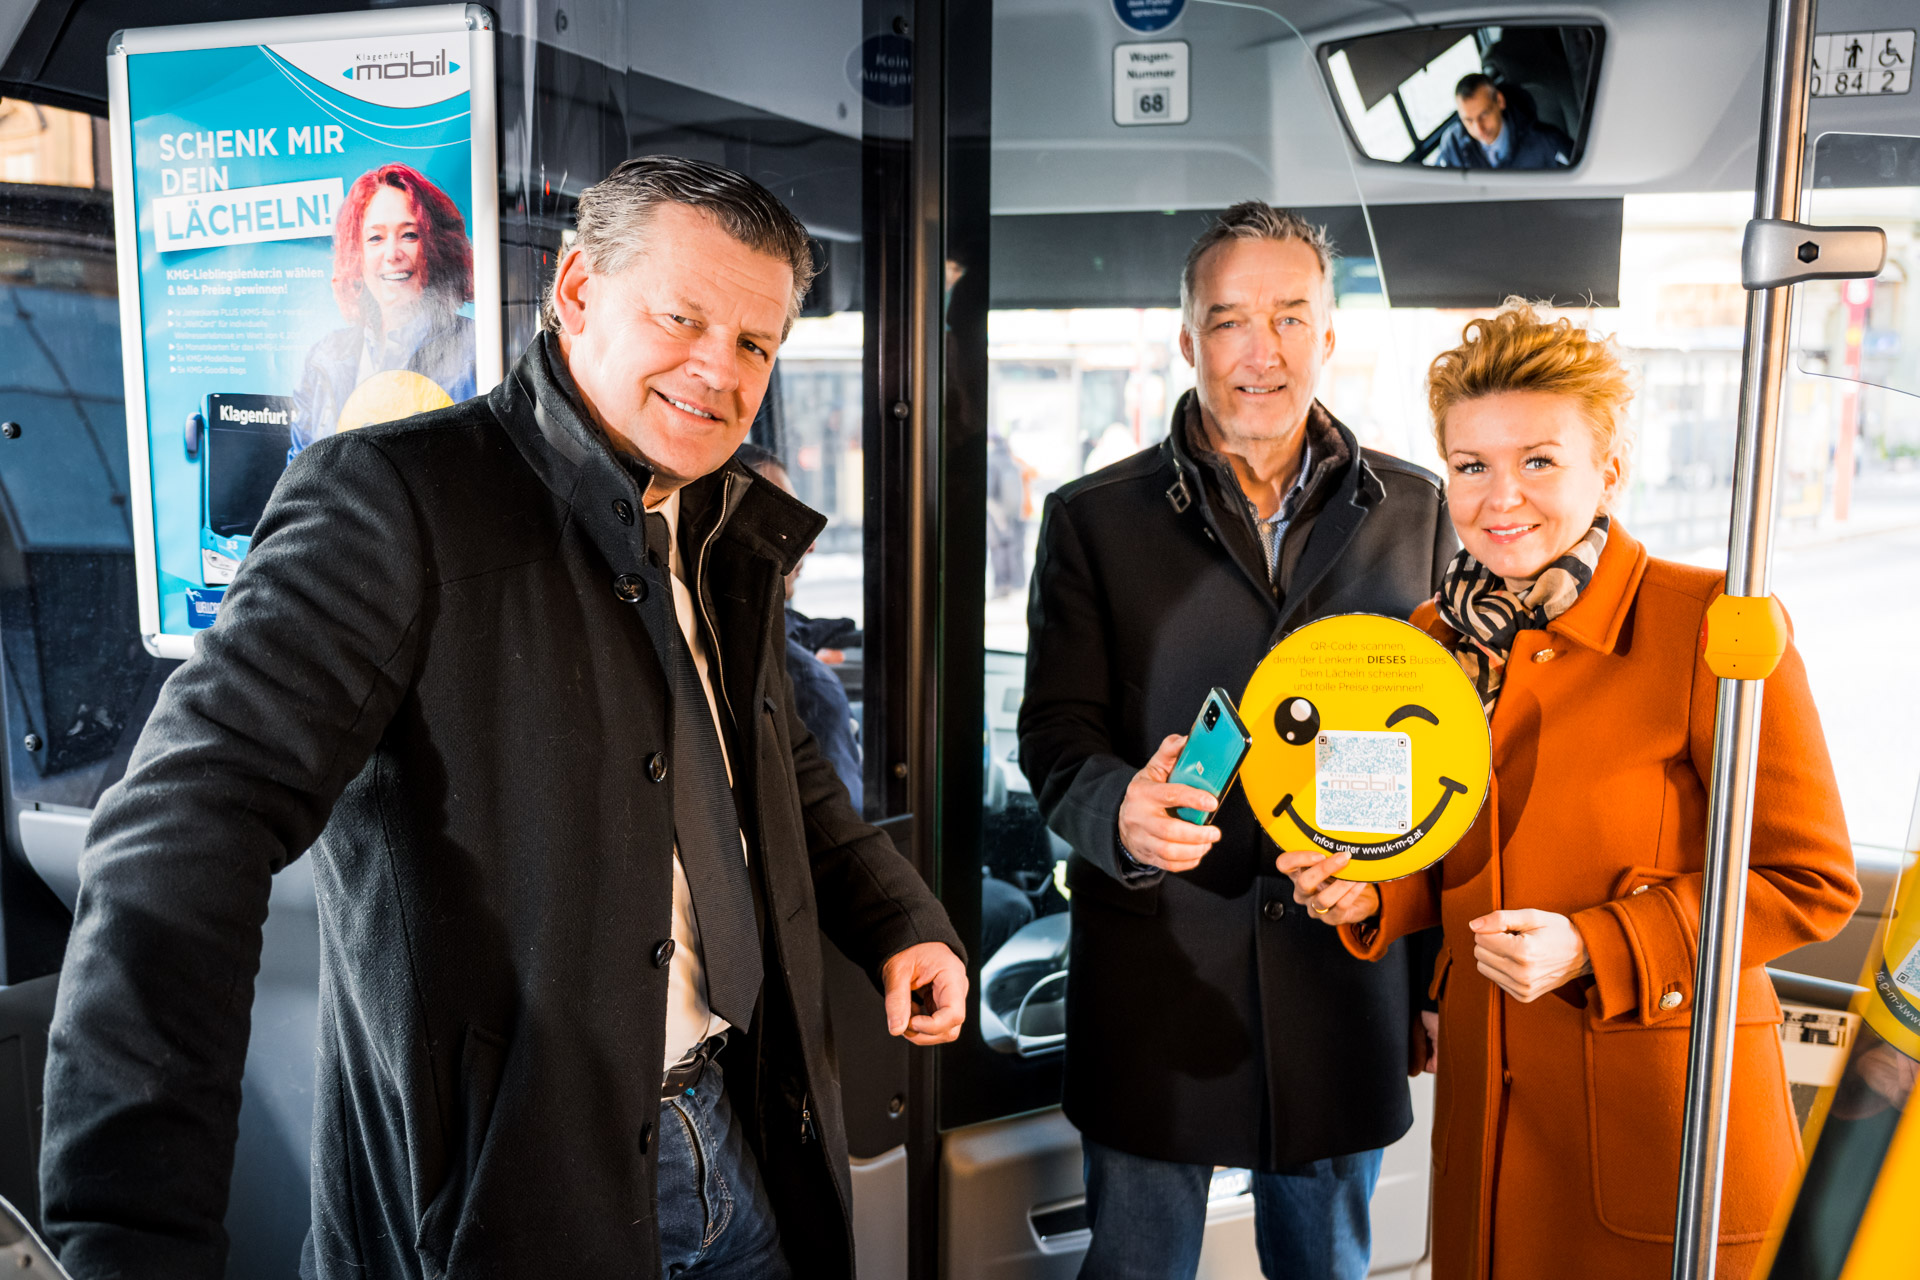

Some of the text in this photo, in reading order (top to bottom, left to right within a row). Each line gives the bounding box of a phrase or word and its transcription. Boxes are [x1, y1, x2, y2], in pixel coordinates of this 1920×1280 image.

[356, 51, 409, 62] Klagenfurt
[356, 48, 446, 80] mobil
[875, 53, 909, 68] Kein
[1129, 51, 1174, 64] Wagen-
[1127, 68, 1176, 80] Nummer
[1835, 72, 1863, 94] 84
[1881, 70, 1895, 92] 2
[1139, 94, 1164, 113] 68
[159, 125, 345, 162] SCHENK MIR
[162, 165, 229, 196] DEIN
[166, 193, 332, 241] LÄCHELN!
[166, 267, 324, 281] KMG-Lieblingslenker:in wählen
[168, 284, 288, 297] & tolle Preise gewinnen!
[219, 404, 288, 425] Klagenfurt
[1310, 641, 1406, 652] QR-Code scannen,
[1273, 655, 1315, 665] dem/der
[1367, 655, 1407, 664] DIESES
[1409, 655, 1447, 665] Busses
[1300, 668, 1417, 678] Dein Lächeln schenken
[1293, 682, 1424, 694] und tolle Preise gewinnen!
[1330, 774, 1396, 791] mobil
[1312, 828, 1424, 855] Infos unter www.k-m-g.at
